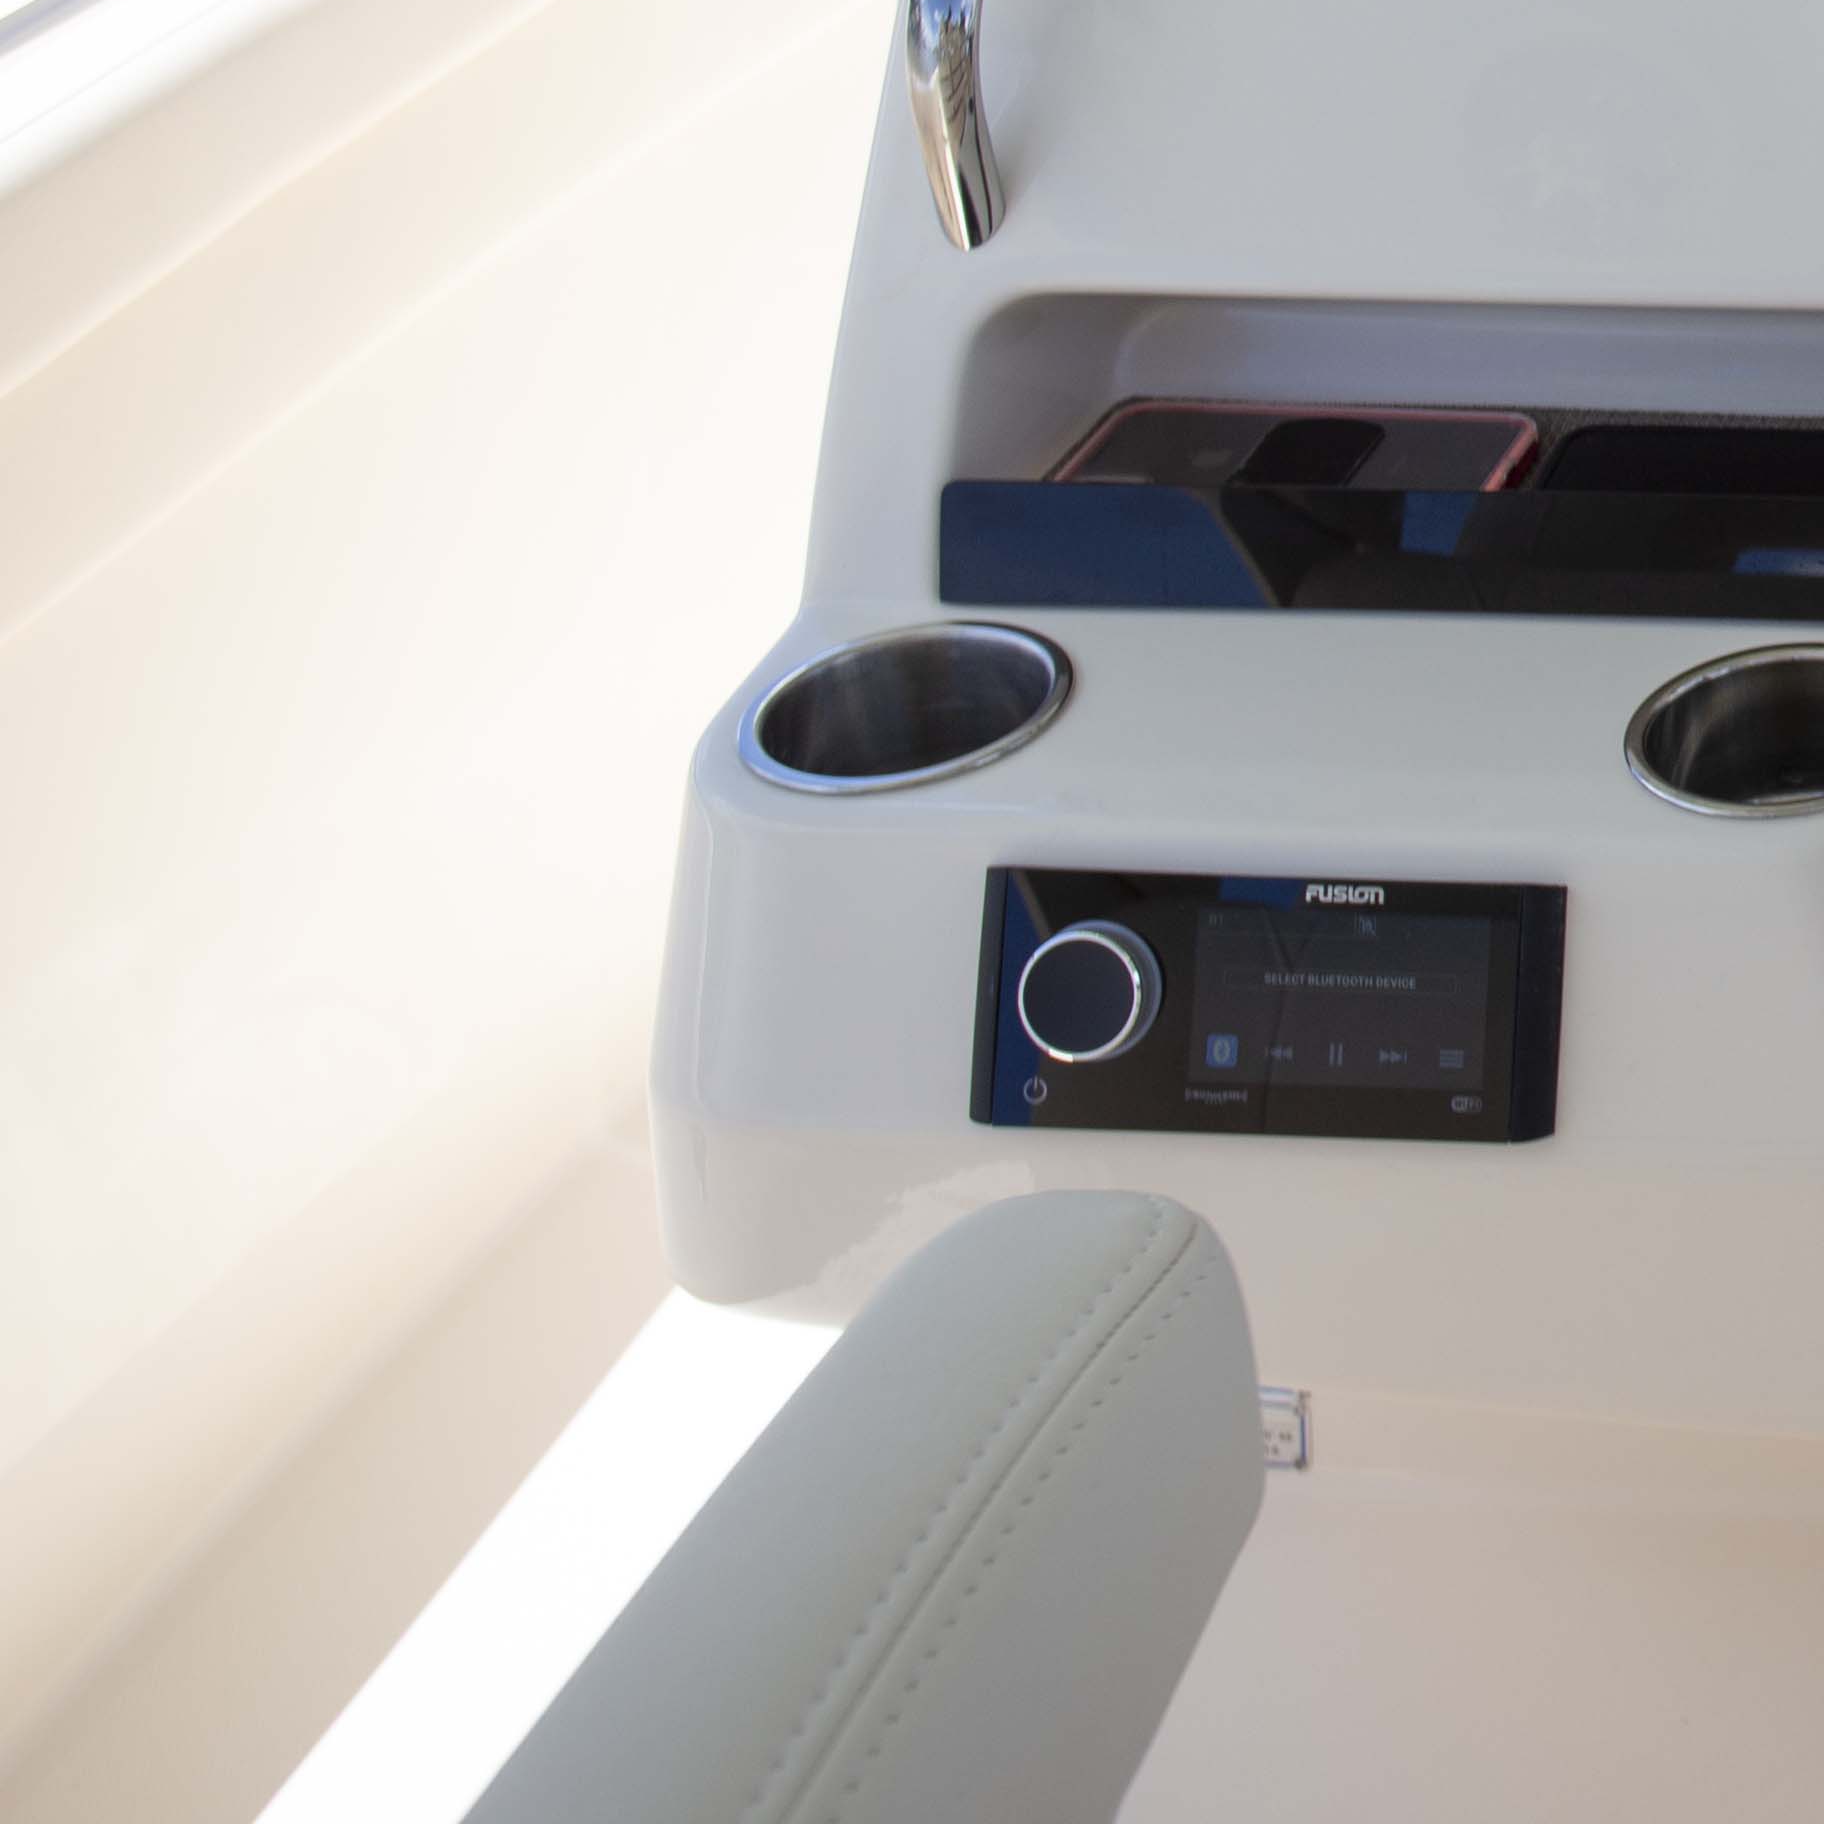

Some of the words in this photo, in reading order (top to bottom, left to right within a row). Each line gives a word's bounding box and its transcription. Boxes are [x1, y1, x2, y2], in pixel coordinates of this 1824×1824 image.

[1305, 883, 1385, 905] FUSION
[1264, 972, 1305, 986] SELECT
[1307, 973, 1373, 989] BLUETOOTH
[1376, 975, 1417, 991] DEVICE
